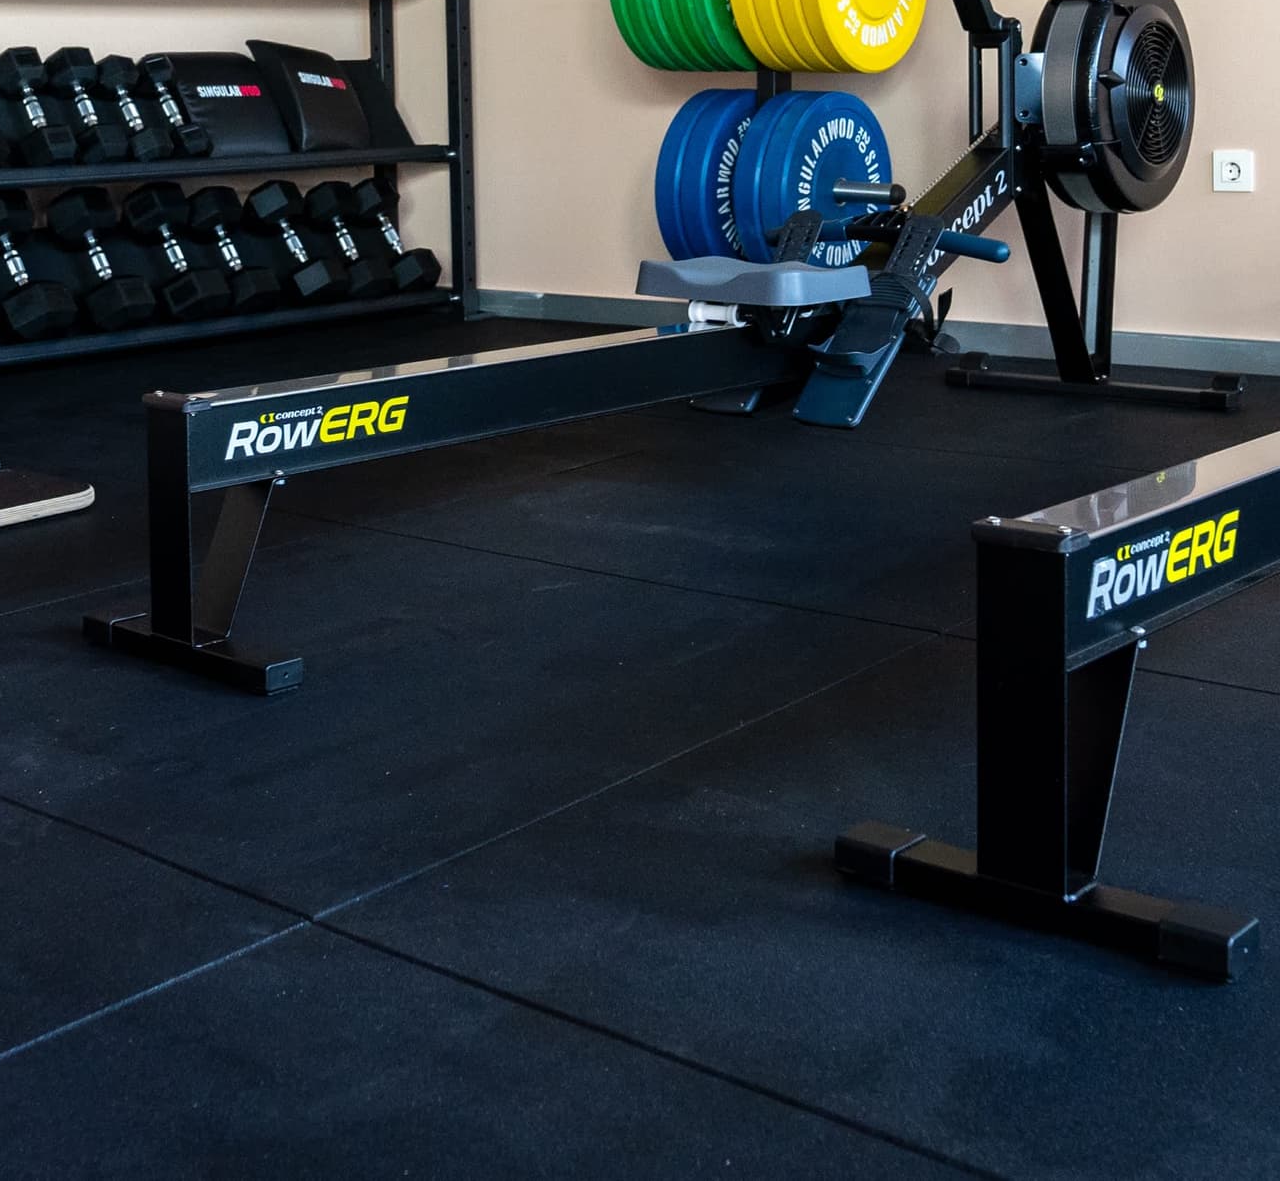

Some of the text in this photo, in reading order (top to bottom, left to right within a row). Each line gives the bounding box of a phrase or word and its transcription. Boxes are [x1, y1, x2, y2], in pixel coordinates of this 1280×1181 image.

[858, 130, 870, 154] 20
[797, 117, 854, 211] NGULARWOD
[995, 169, 1007, 194] 2
[275, 407, 316, 420] concept
[1130, 534, 1165, 555] concept
